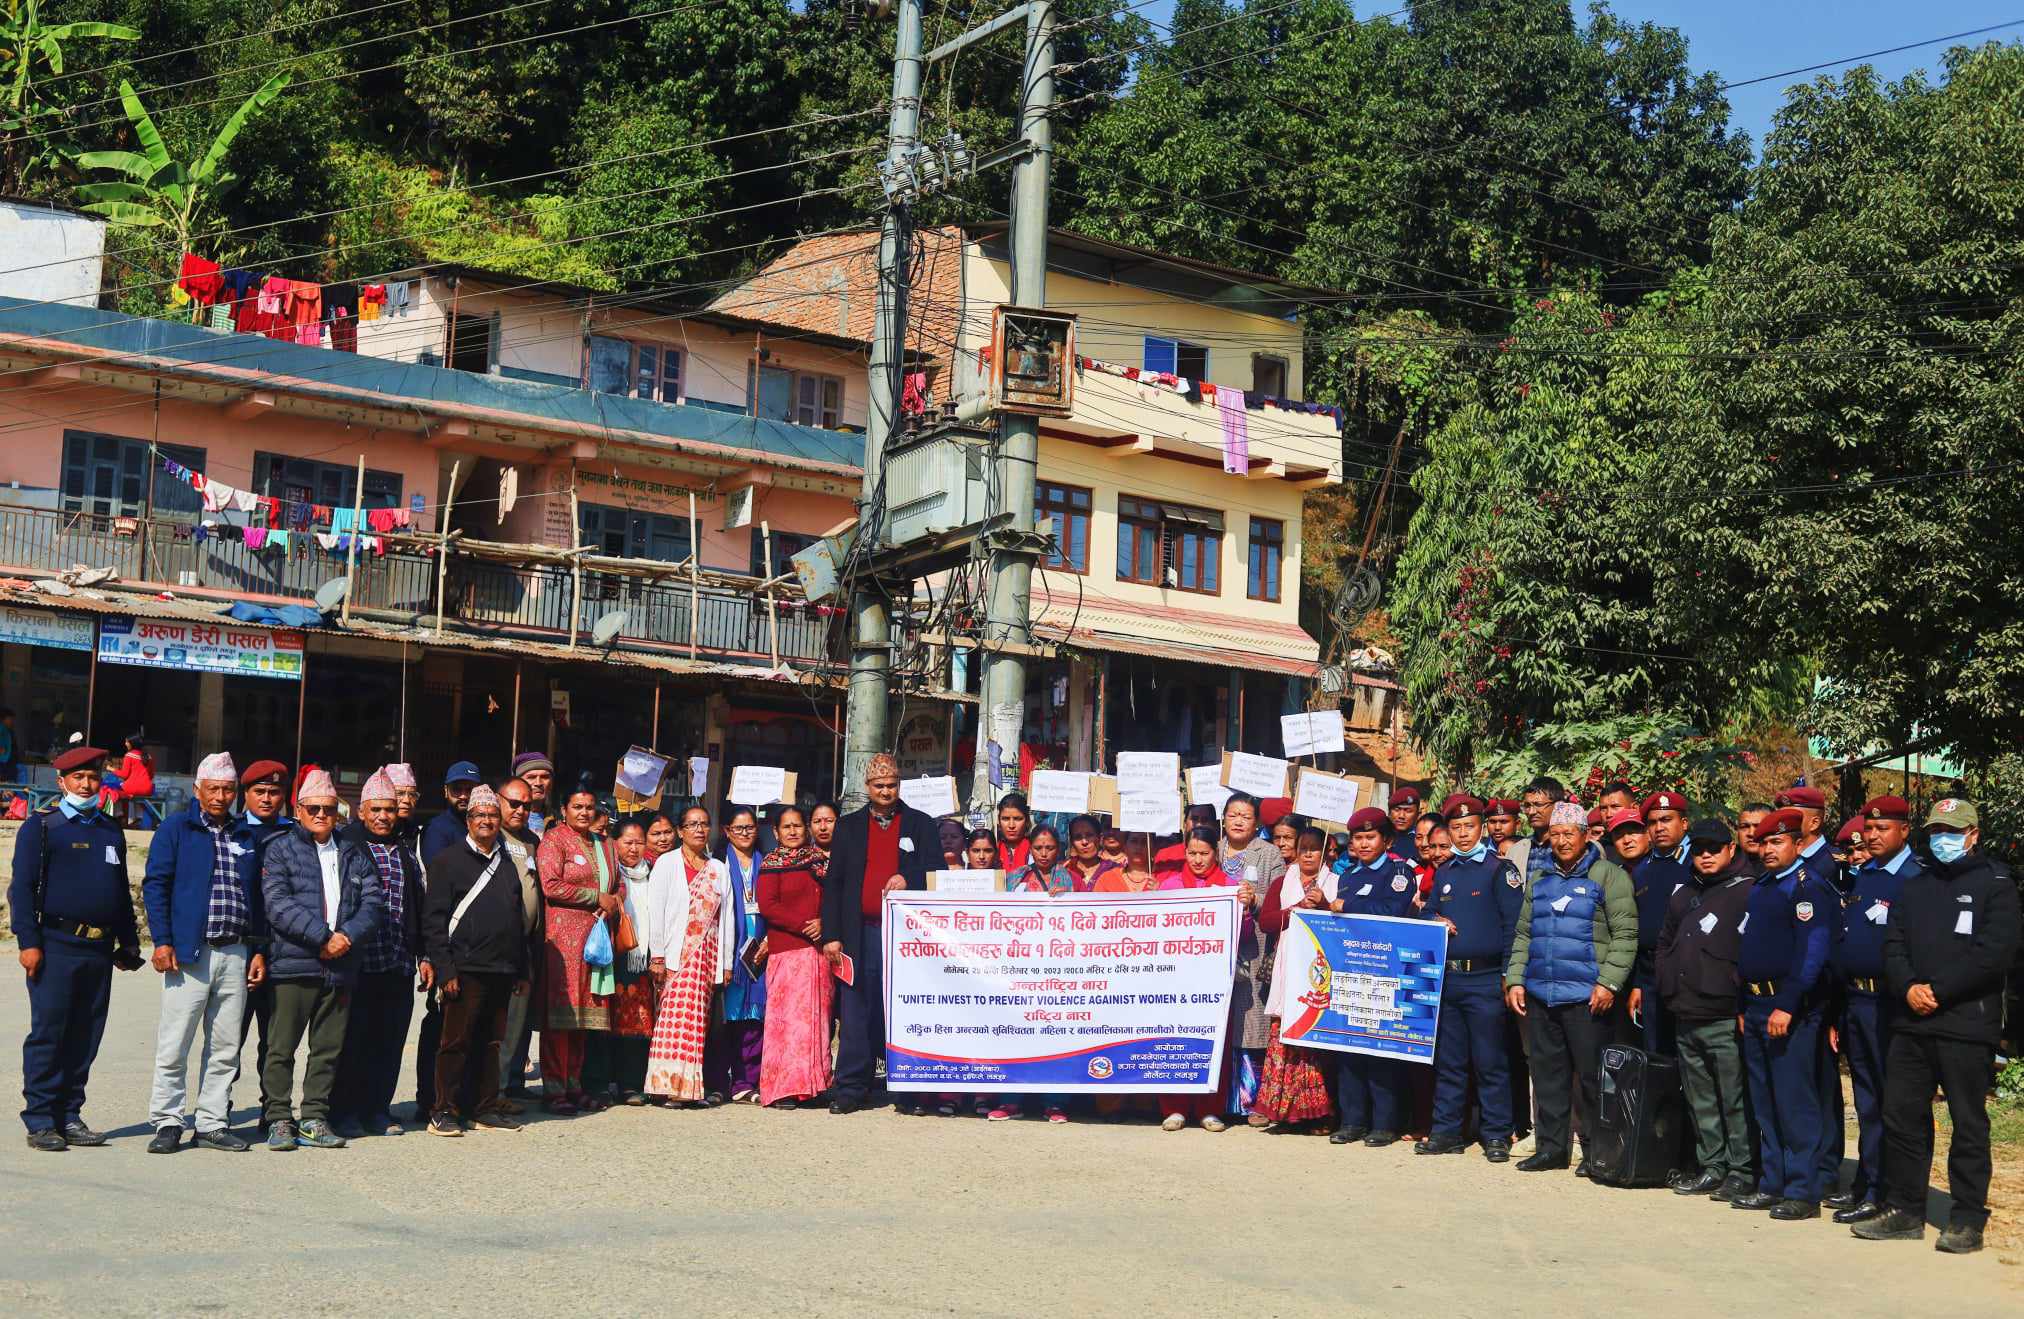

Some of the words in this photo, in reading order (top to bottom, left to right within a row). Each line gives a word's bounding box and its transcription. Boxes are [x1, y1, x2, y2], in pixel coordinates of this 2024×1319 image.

[191, 625, 221, 646] डेरी
[226, 631, 269, 650] पसल
[1072, 911, 1096, 930] दिने
[1102, 910, 1157, 930] अभियान
[1162, 908, 1216, 928] अन्तर्गत
[1050, 938, 1075, 958] दिने
[1080, 937, 1159, 958] अन्तरक्रिया
[1163, 936, 1224, 956] कार्यक्रम
[1082, 979, 1108, 991] नारा
[938, 995, 971, 1005] INVEST
[974, 995, 986, 1005] TO
[989, 995, 1035, 1005] PREVENT
[1037, 995, 1086, 1005] VIOLENCE
[1088, 994, 1136, 1005] AGAINIST
[1138, 994, 1177, 1004] WOMEN
[1180, 994, 1187, 1004] &
[1066, 1011, 1092, 1021] नारा
